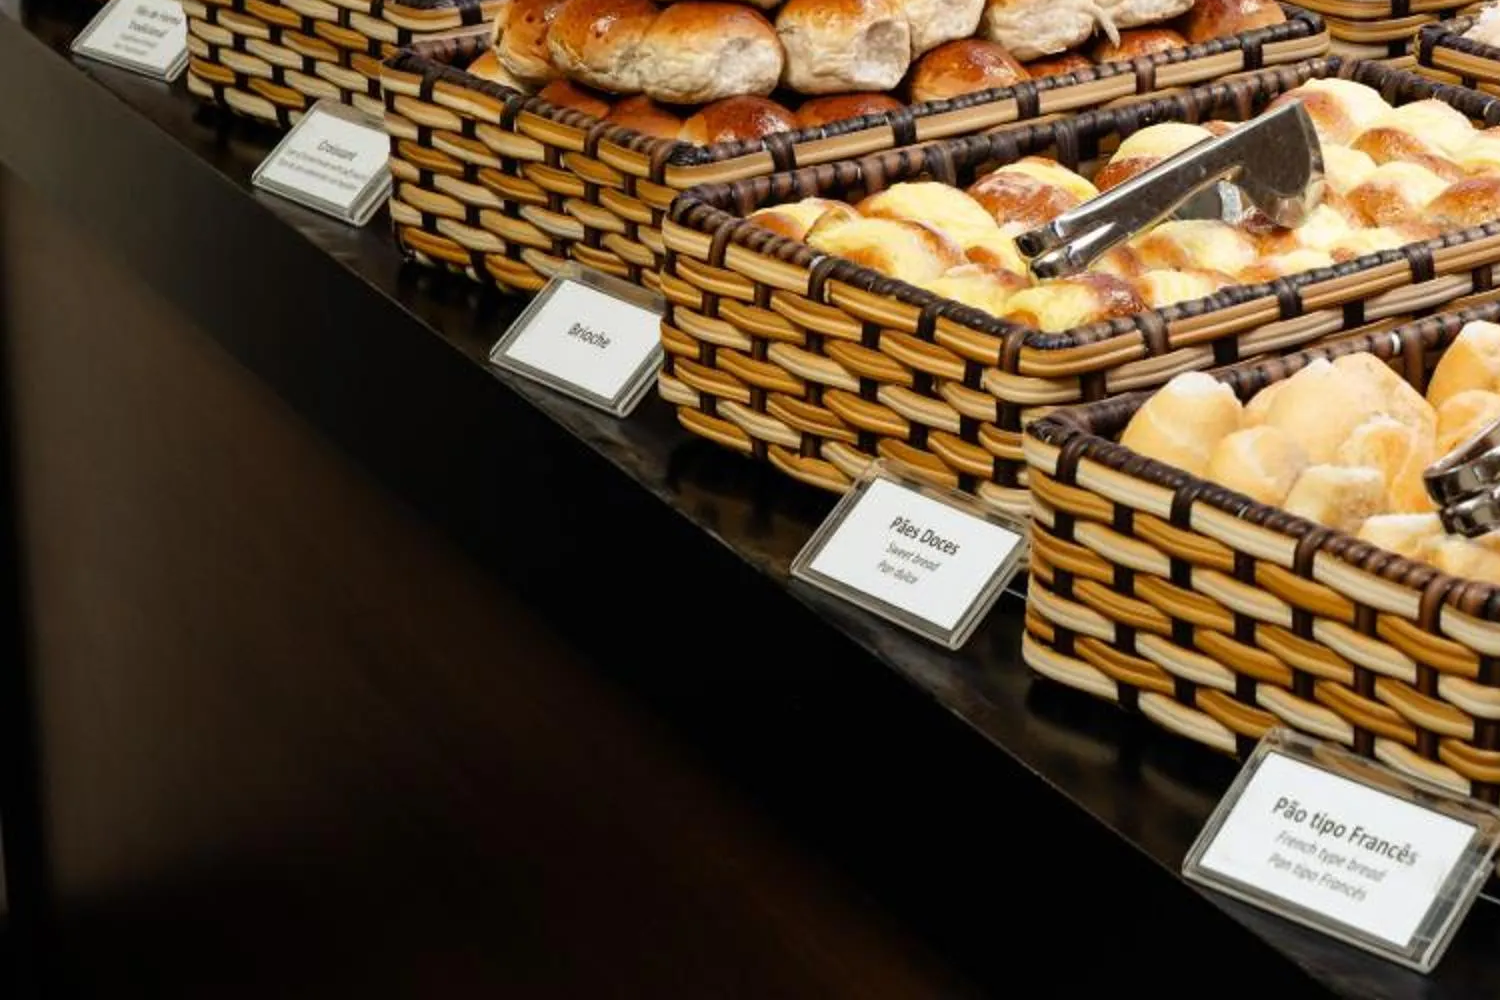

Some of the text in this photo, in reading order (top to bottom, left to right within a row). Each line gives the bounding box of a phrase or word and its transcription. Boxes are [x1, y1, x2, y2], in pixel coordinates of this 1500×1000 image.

[568, 322, 611, 349] Brioche
[890, 516, 961, 556] Pães Doces
[1272, 797, 1419, 867] Pão tipo Francês
[1275, 830, 1387, 883] French type bread
